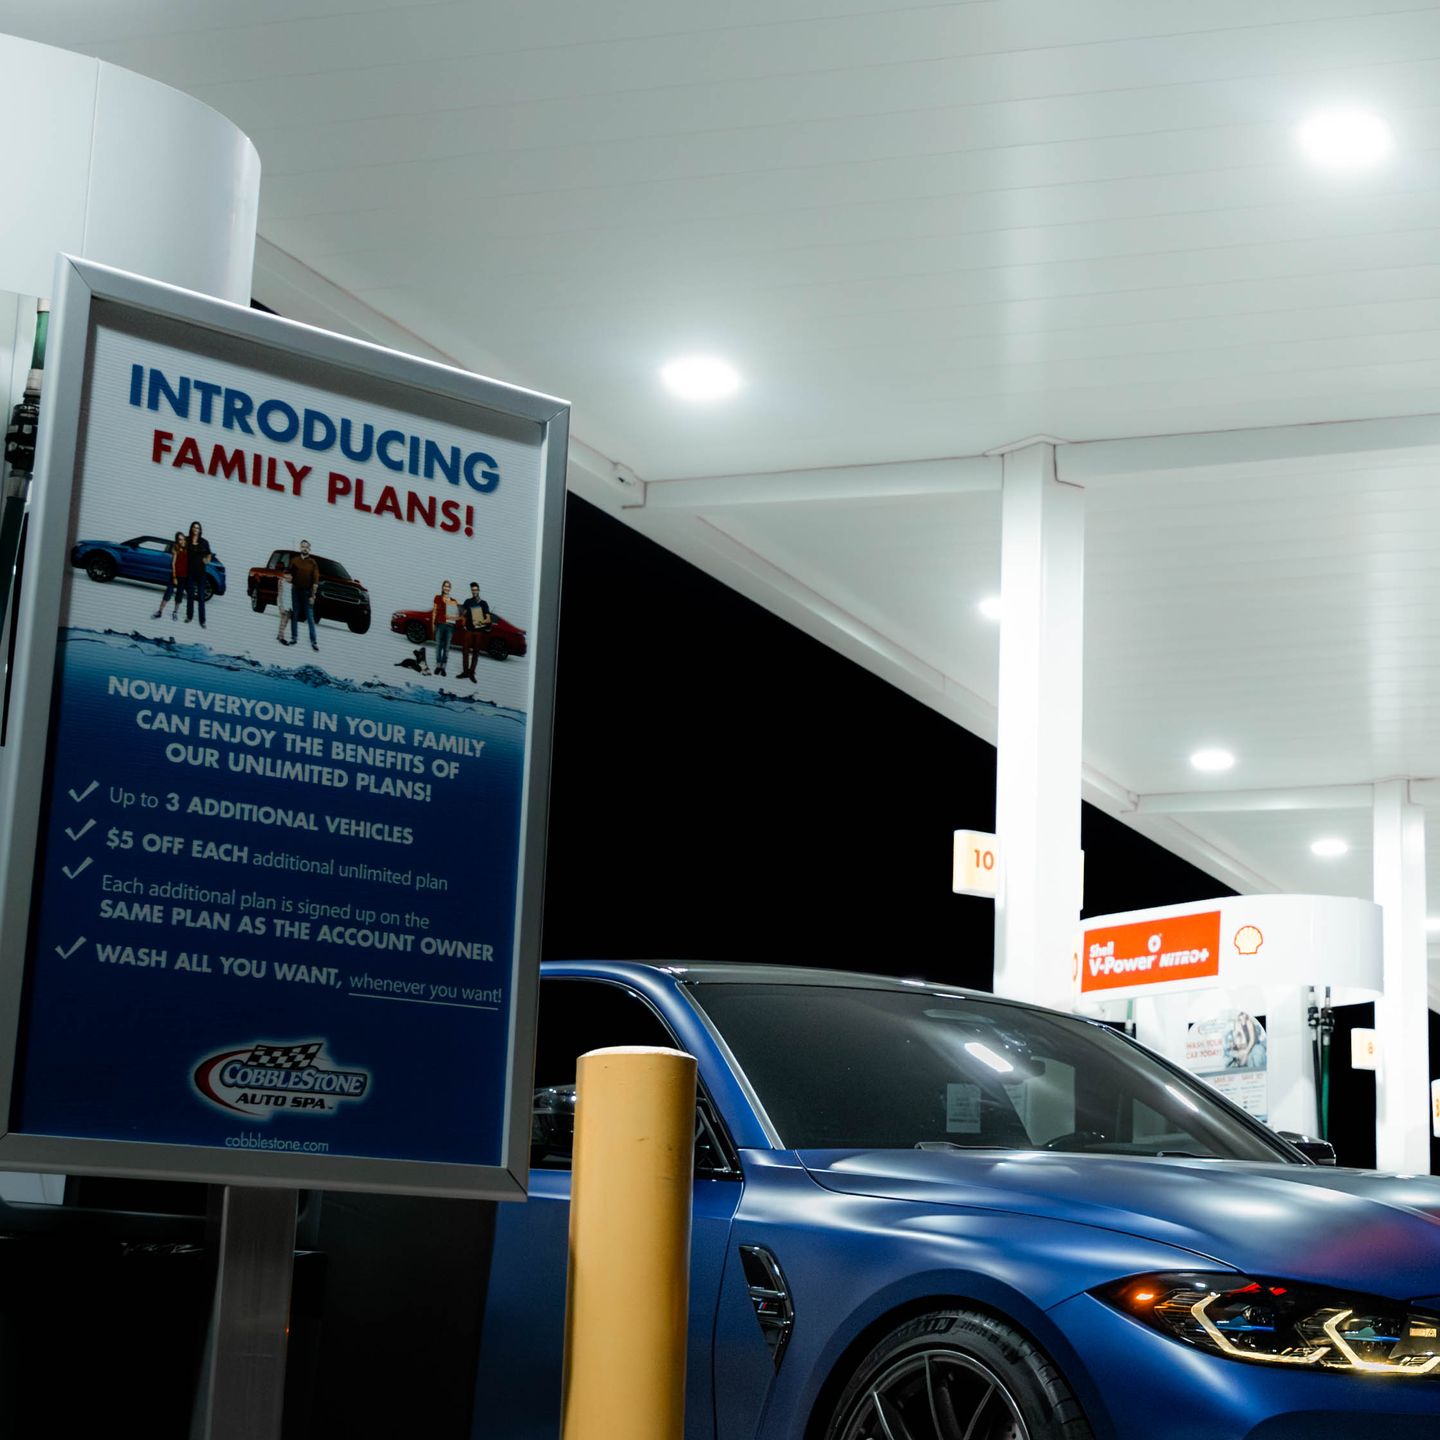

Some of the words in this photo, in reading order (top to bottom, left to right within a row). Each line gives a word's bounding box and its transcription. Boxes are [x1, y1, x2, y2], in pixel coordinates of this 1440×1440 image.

[129, 363, 500, 495] INTRODUCING
[152, 429, 312, 496] FAMILY
[327, 472, 475, 537] PLANS!
[108, 676, 176, 704] NOW
[184, 688, 305, 726] EVERYONE
[313, 710, 337, 732] IN
[346, 716, 406, 744] YOUR
[414, 729, 486, 757] FAMILY
[136, 710, 190, 735] CAN
[199, 719, 276, 748] ENJOY
[284, 733, 323, 757] THE
[332, 741, 424, 774] BENEFITS
[432, 759, 460, 779] OF
[166, 743, 220, 768] OUR
[228, 752, 348, 788] UNLIMITED
[356, 773, 432, 802] PLANS!
[109, 786, 135, 808] Up
[140, 793, 158, 808] to
[166, 792, 180, 811] 3
[186, 796, 319, 830] ADDITIONAL
[325, 815, 414, 844] VEHICLES
[106, 827, 134, 850] $5
[142, 833, 184, 855] OFF
[192, 840, 248, 864] EACH
[252, 852, 334, 875] additional
[339, 864, 412, 886] unlimited
[416, 872, 448, 891] plan
[974, 848, 994, 871] 10
[99, 900, 164, 924] SAME
[172, 908, 230, 931] PLAN
[237, 915, 266, 935] AS
[274, 919, 310, 940] THE
[317, 925, 414, 952] ACCOUNT
[420, 937, 494, 961] OWNER
[102, 874, 144, 894] Each
[149, 882, 236, 905] additional
[240, 892, 276, 910] plan
[282, 896, 293, 912] is
[298, 900, 350, 920] signed
[356, 909, 376, 926] up
[380, 912, 400, 926] on
[405, 912, 430, 929] the
[96, 943, 168, 968] WASH
[174, 952, 212, 974] ALL
[220, 956, 266, 978] YOU
[274, 962, 342, 989] WANT,
[350, 973, 426, 994] whenever
[430, 984, 457, 1000] you
[462, 986, 502, 1003] want!
[1088, 954, 1156, 977] V-Power
[1090, 941, 1114, 958] Shell
[236, 1093, 286, 1107] AUTO
[291, 1097, 326, 1109] SPA
[225, 1132, 329, 1152] cobblestone.com
